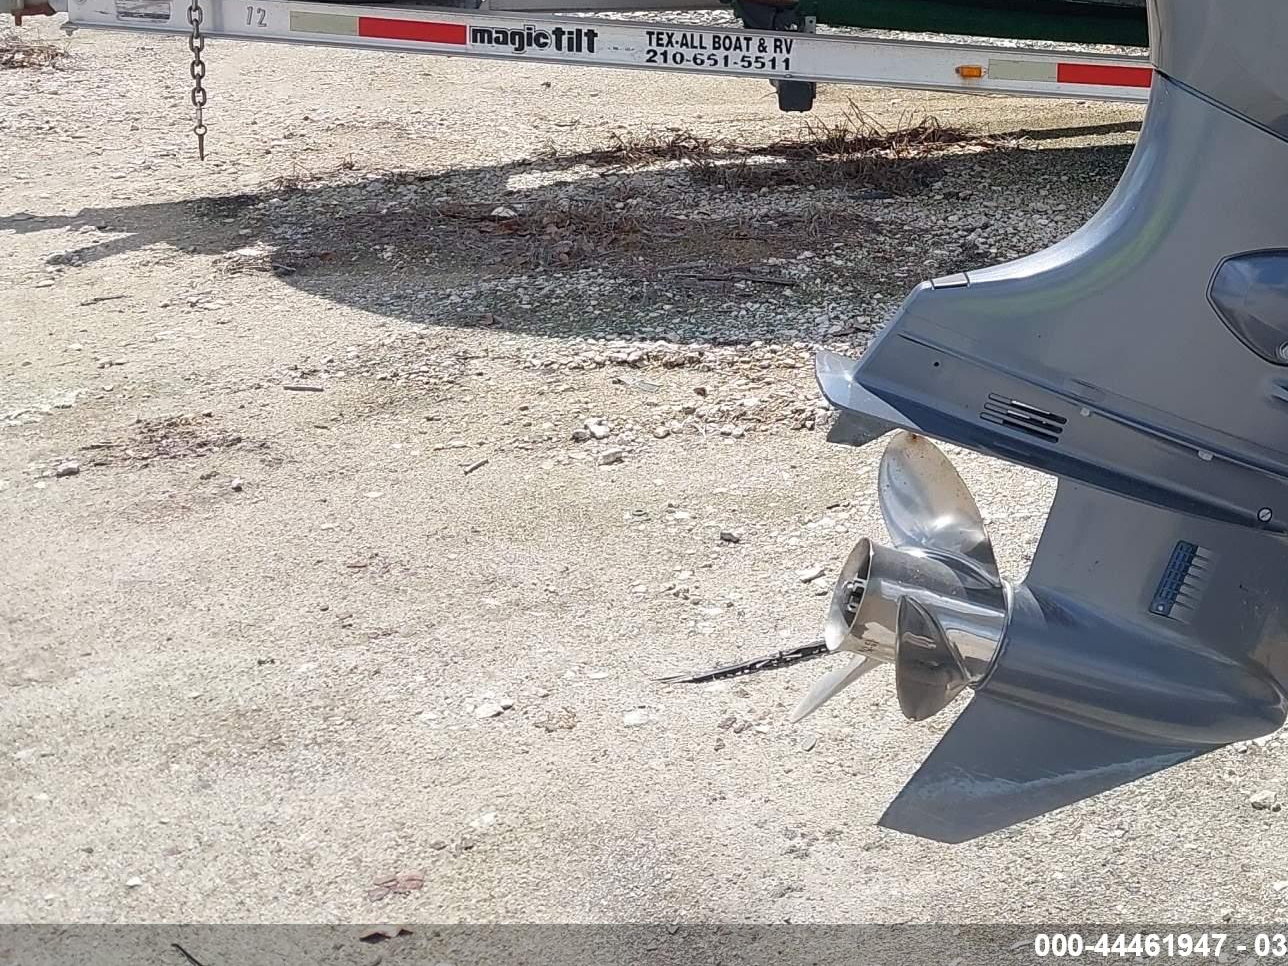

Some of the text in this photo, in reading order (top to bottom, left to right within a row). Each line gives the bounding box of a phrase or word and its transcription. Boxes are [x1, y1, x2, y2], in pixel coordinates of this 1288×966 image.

[246, 6, 268, 28] 12
[646, 31, 793, 55] TEX-ALL BOAT & RV
[645, 49, 790, 71] 210-651-5511
